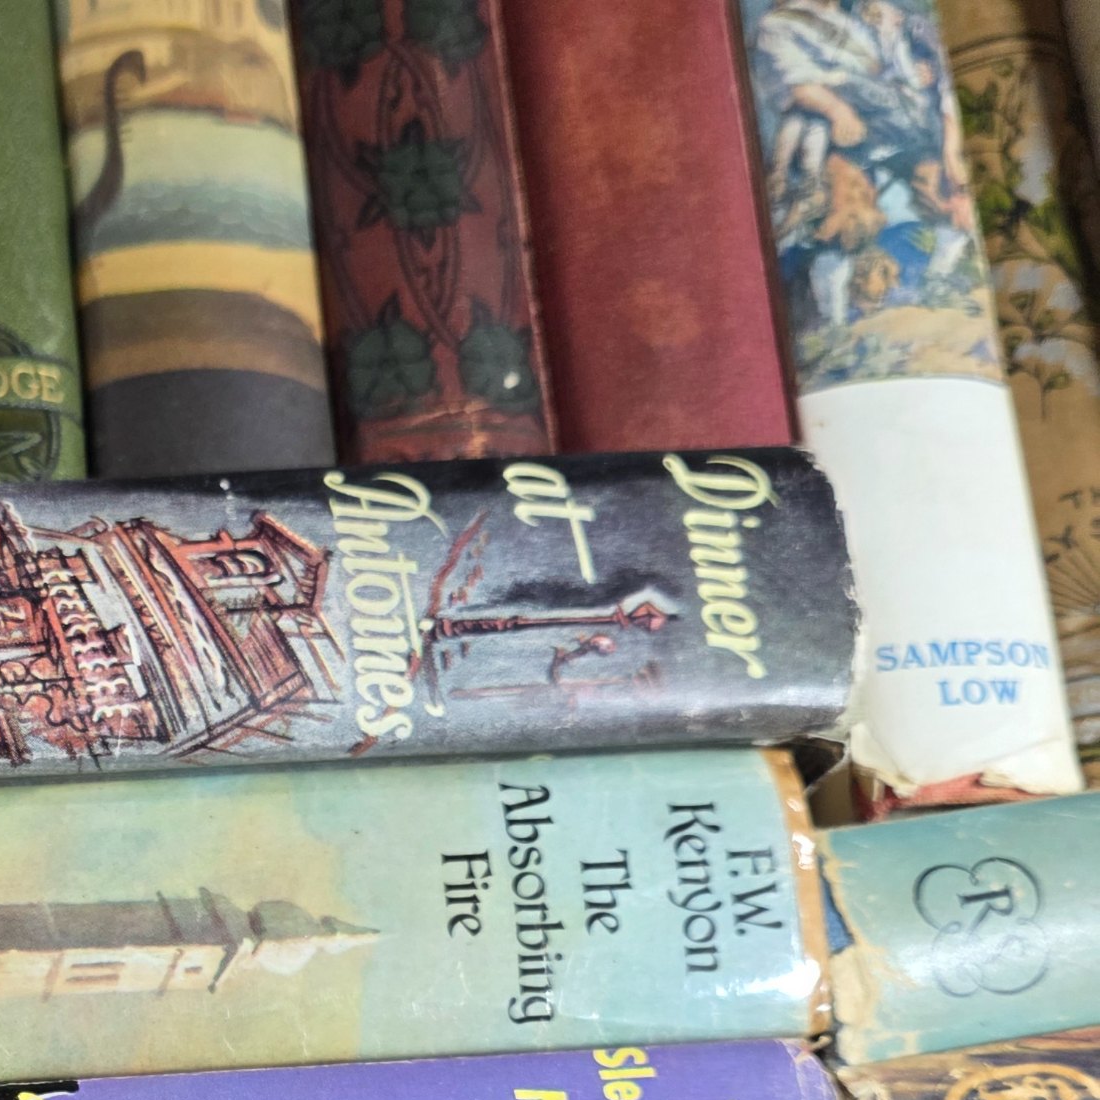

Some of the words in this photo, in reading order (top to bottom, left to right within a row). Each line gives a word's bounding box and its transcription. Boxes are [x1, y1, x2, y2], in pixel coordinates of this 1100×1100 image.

[502, 462, 596, 584] at
[662, 454, 782, 680] Dinner
[323, 470, 447, 741] Antoine's
[876, 640, 1050, 673] SAMPSON
[938, 679, 1021, 706] LOW
[440, 849, 495, 937] Fire
[499, 781, 566, 1025] Absorbing
[579, 848, 633, 936] The
[663, 801, 722, 974] Kenyon
